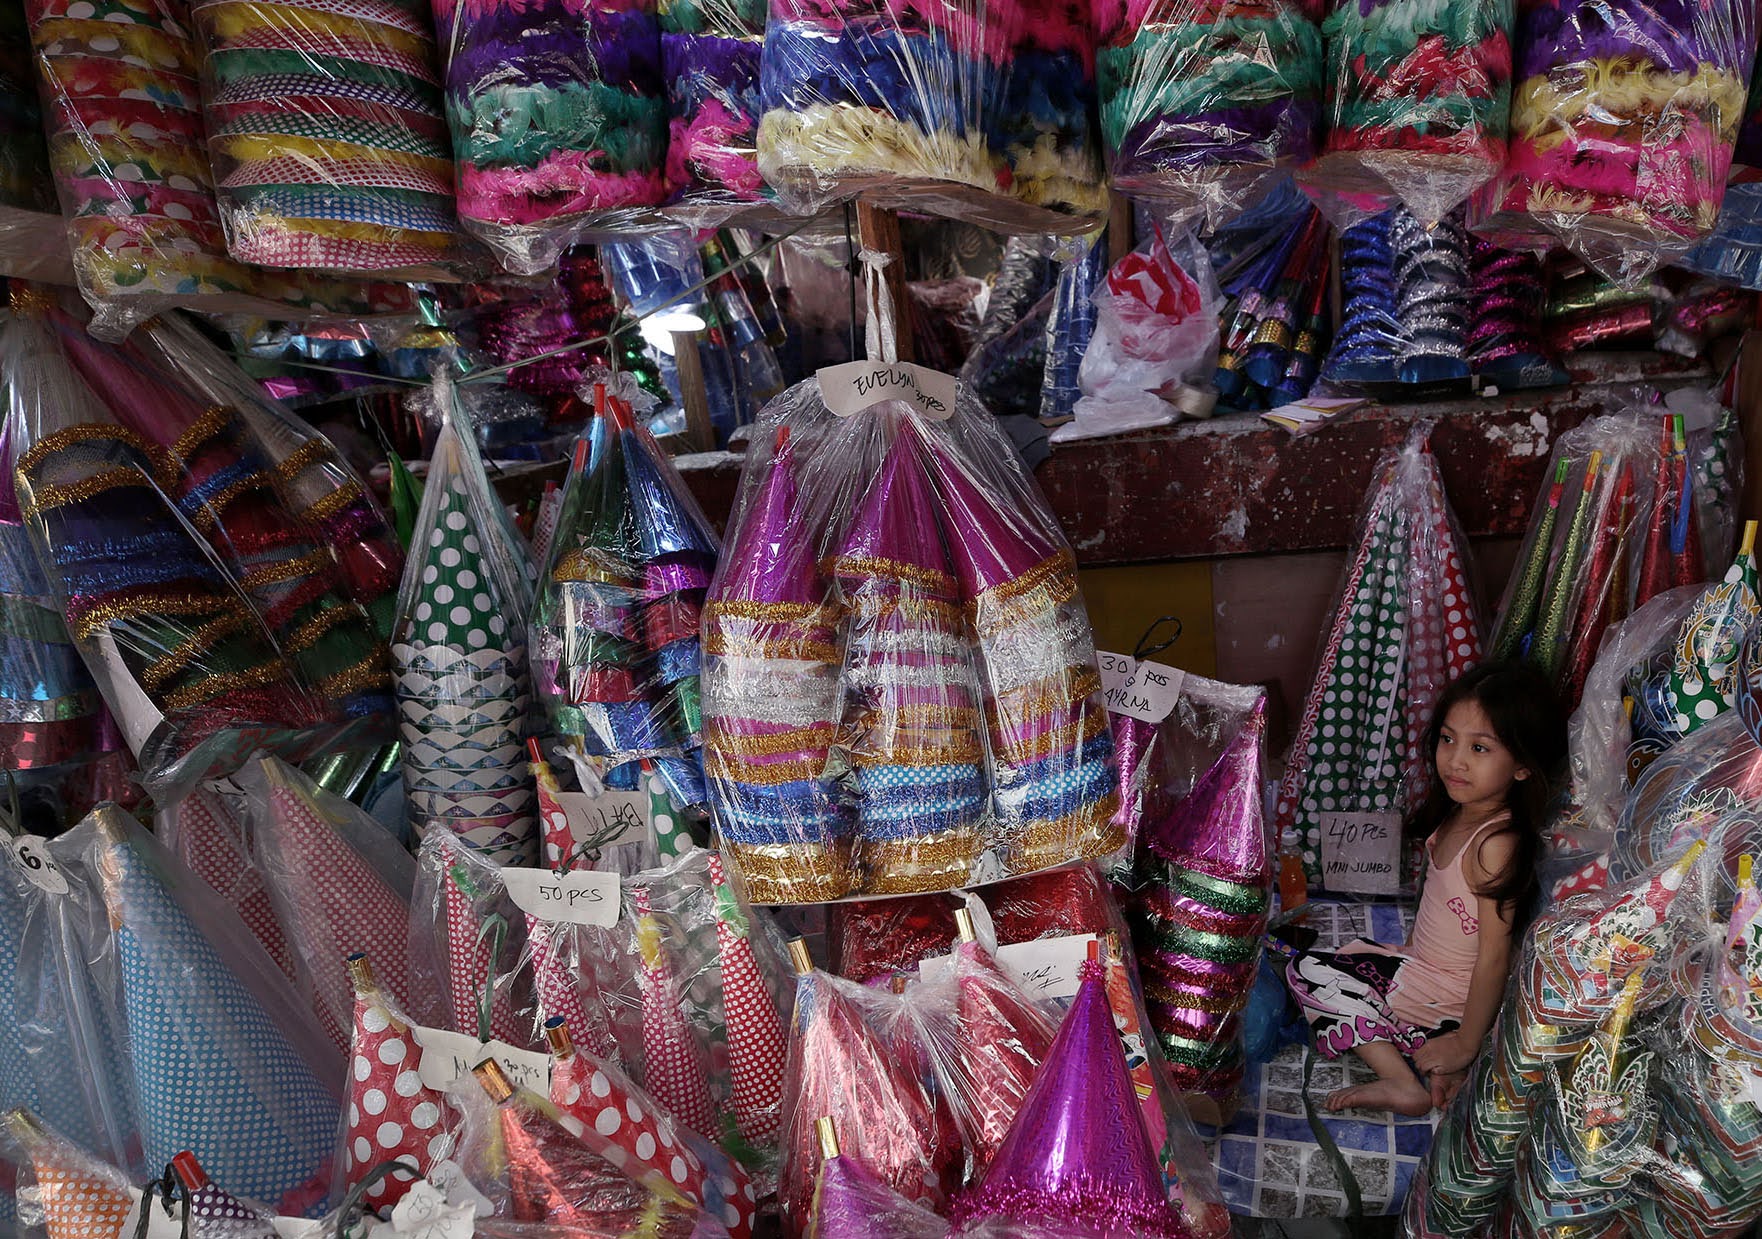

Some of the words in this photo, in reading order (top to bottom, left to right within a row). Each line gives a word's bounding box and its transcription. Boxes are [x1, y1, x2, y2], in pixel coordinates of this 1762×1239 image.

[853, 369, 914, 395] EVELYN
[1102, 656, 1128, 673] 30
[1144, 670, 1170, 686] pcs
[1329, 818, 1358, 849] 40
[1351, 862, 1392, 873] JUMBO
[539, 885, 562, 900] 50
[567, 888, 603, 906] pcs
